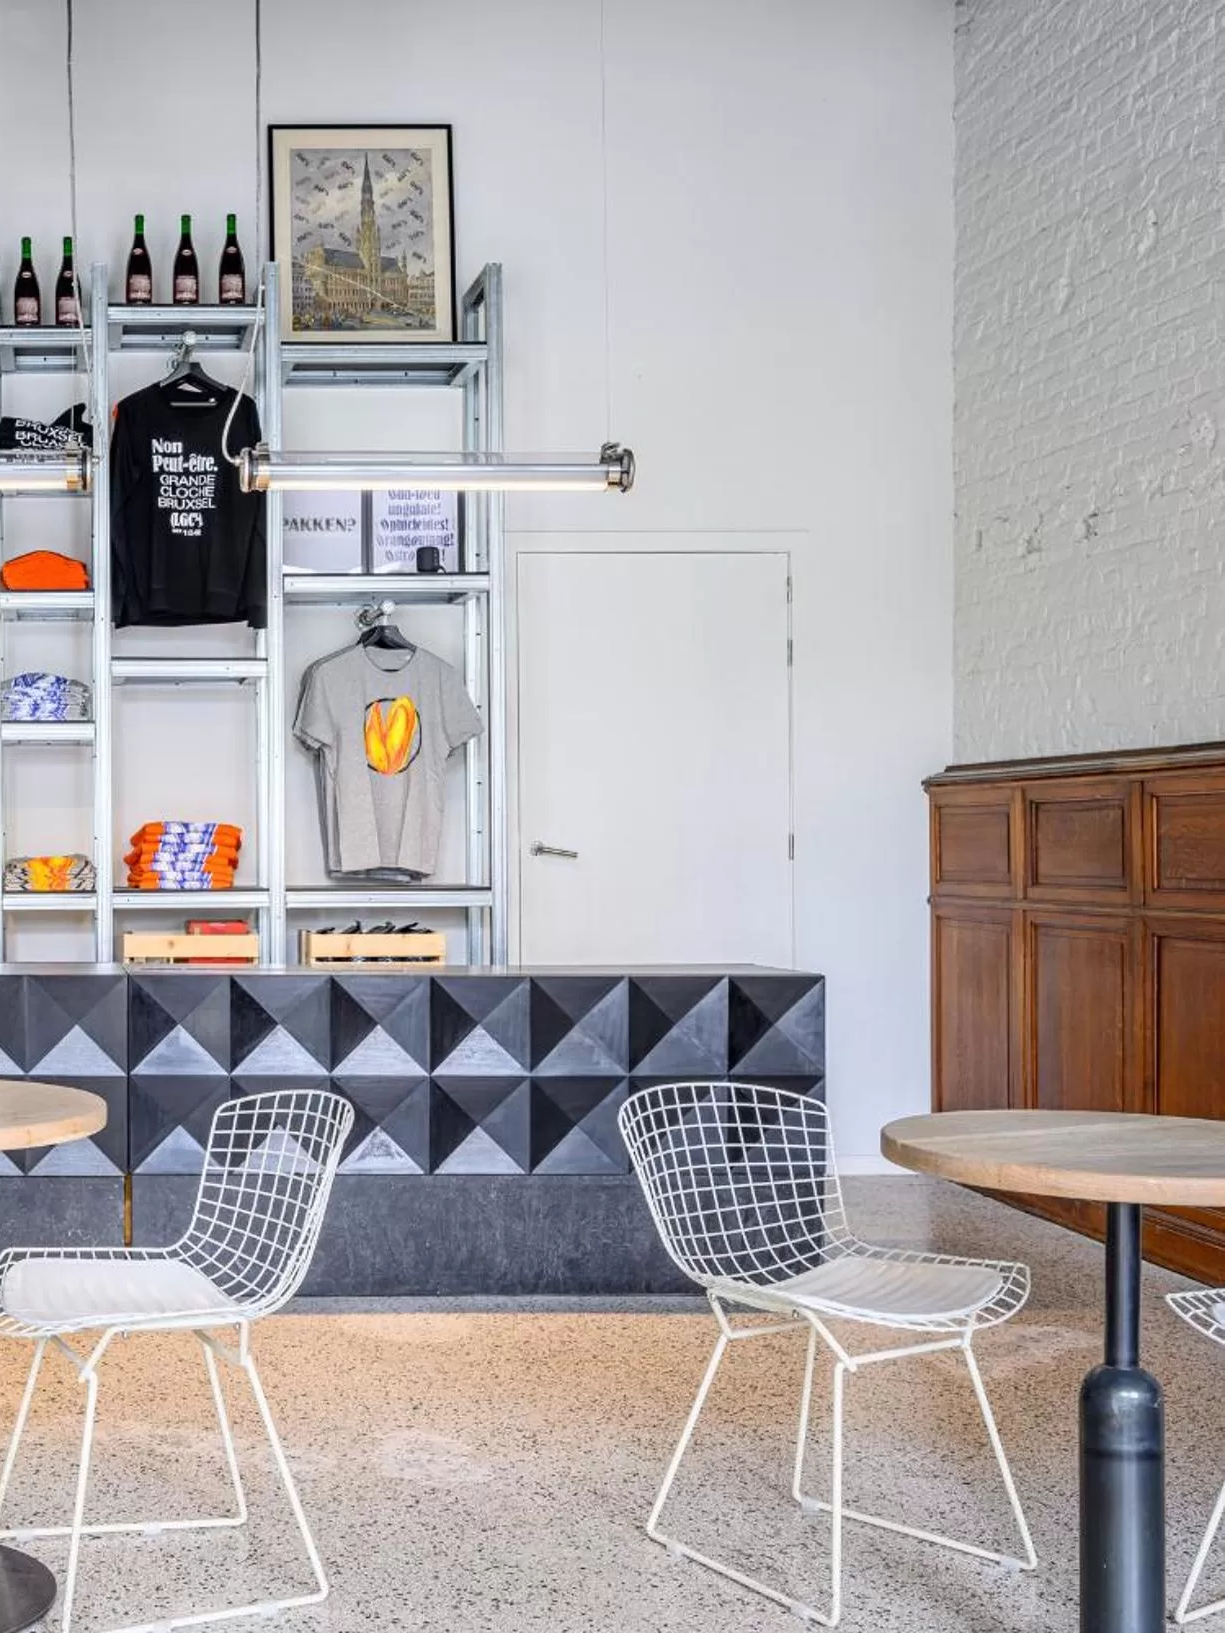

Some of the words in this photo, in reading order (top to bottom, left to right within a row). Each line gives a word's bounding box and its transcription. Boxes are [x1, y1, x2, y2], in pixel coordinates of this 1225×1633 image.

[151, 437, 183, 454] Non
[151, 453, 218, 473] Peut-être.
[159, 474, 216, 487] GRANDE
[159, 486, 215, 499] CLOCHE
[157, 497, 217, 510] BRUXSEL
